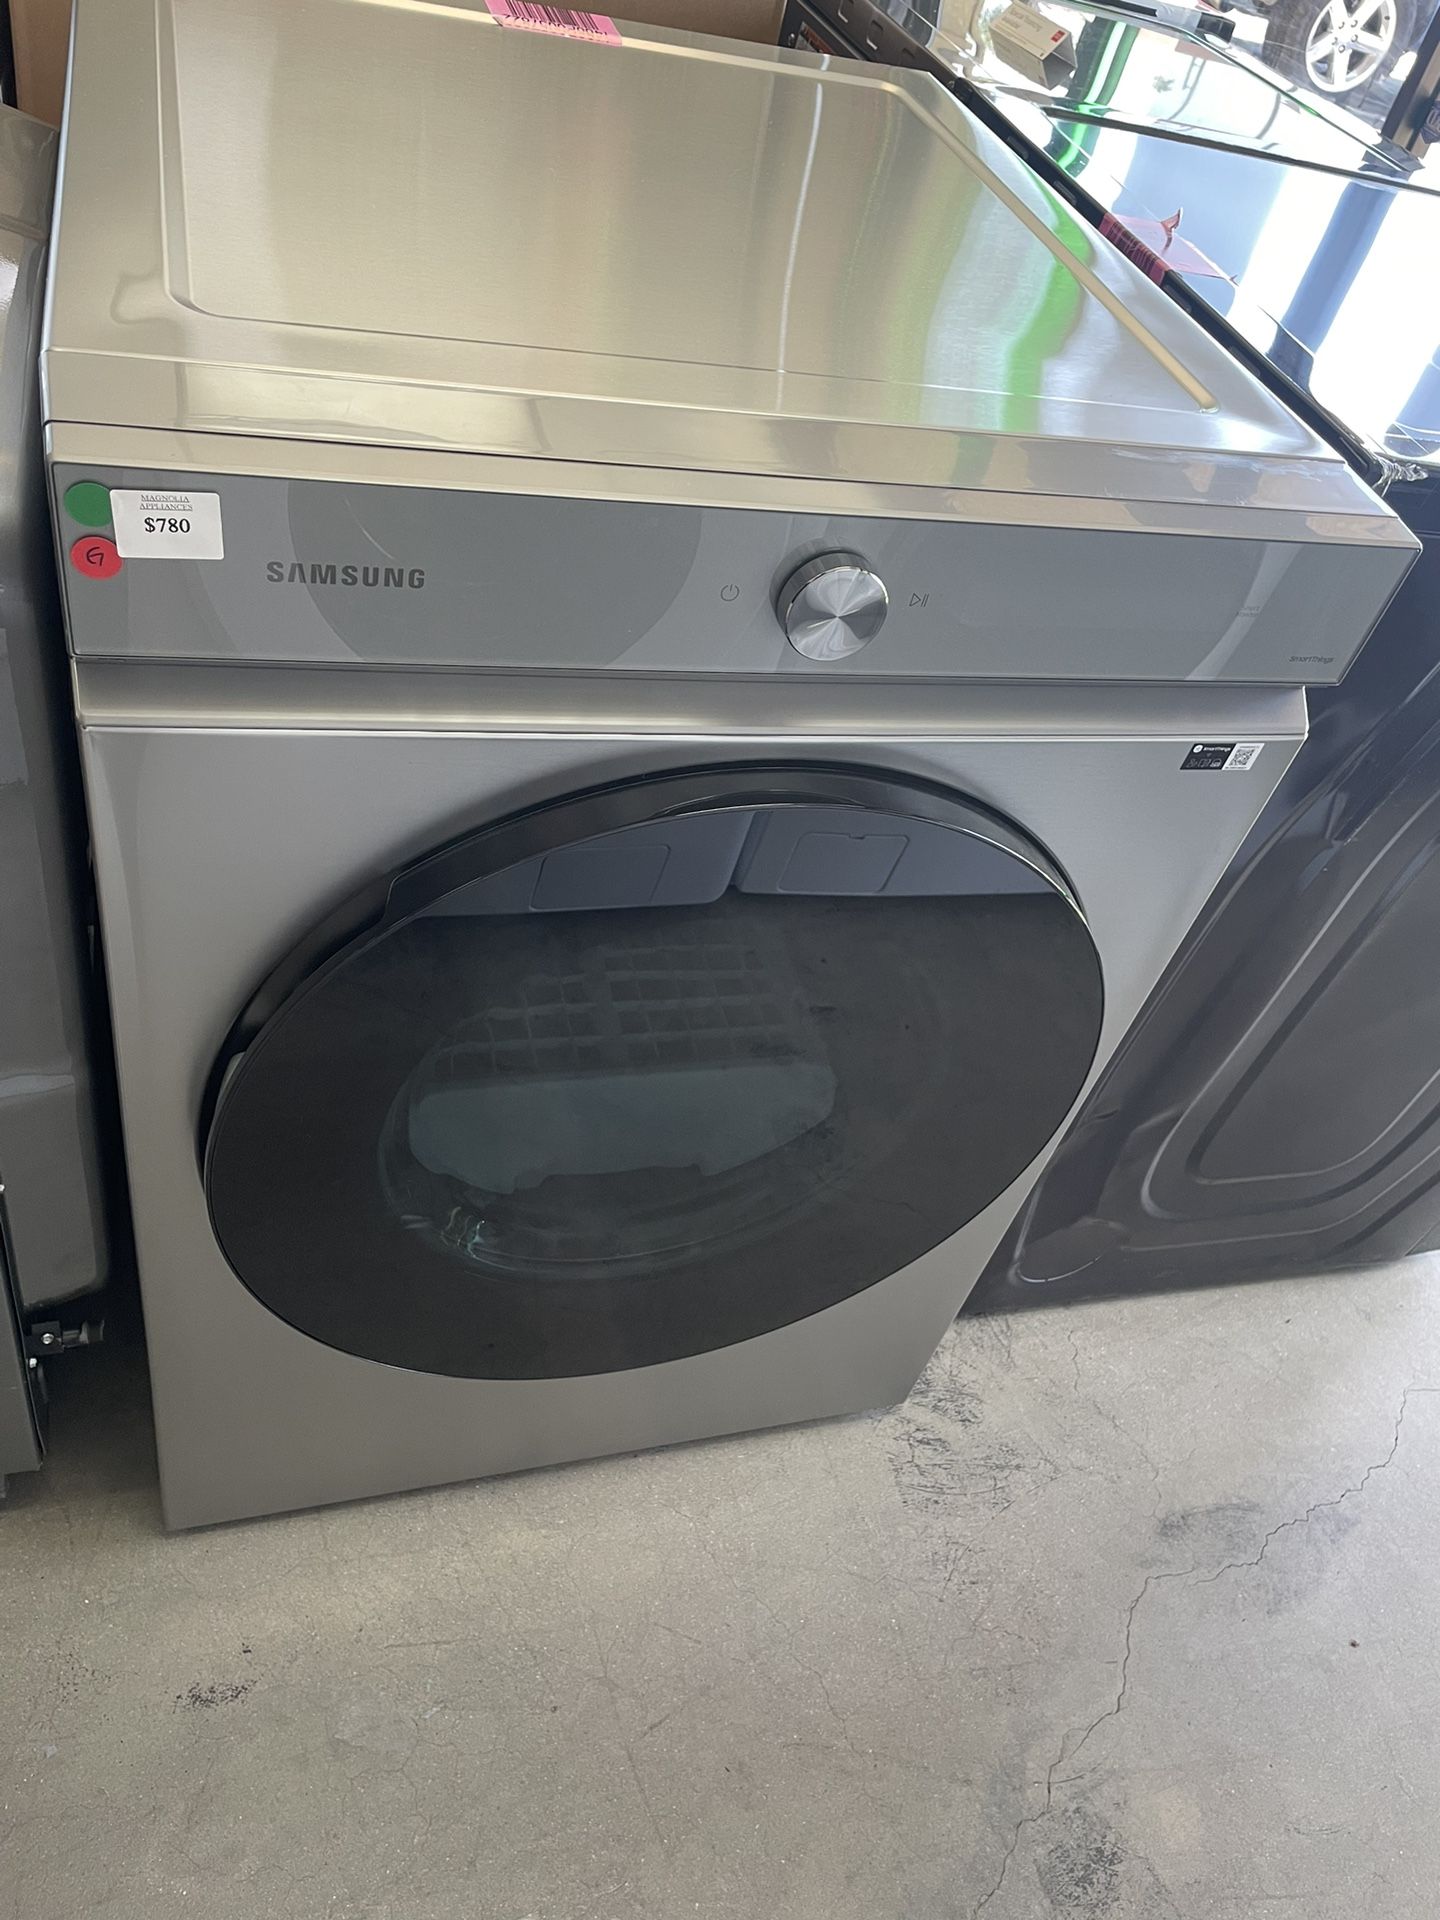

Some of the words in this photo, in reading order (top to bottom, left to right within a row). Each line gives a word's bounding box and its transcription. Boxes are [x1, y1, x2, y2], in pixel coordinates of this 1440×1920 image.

[140, 494, 190, 502] MAGNOLIA
[139, 502, 193, 511] APPLIANCES
[144, 516, 191, 533] $780
[266, 561, 426, 589] SAMSUNG
[1288, 655, 1335, 664] SmartThings
